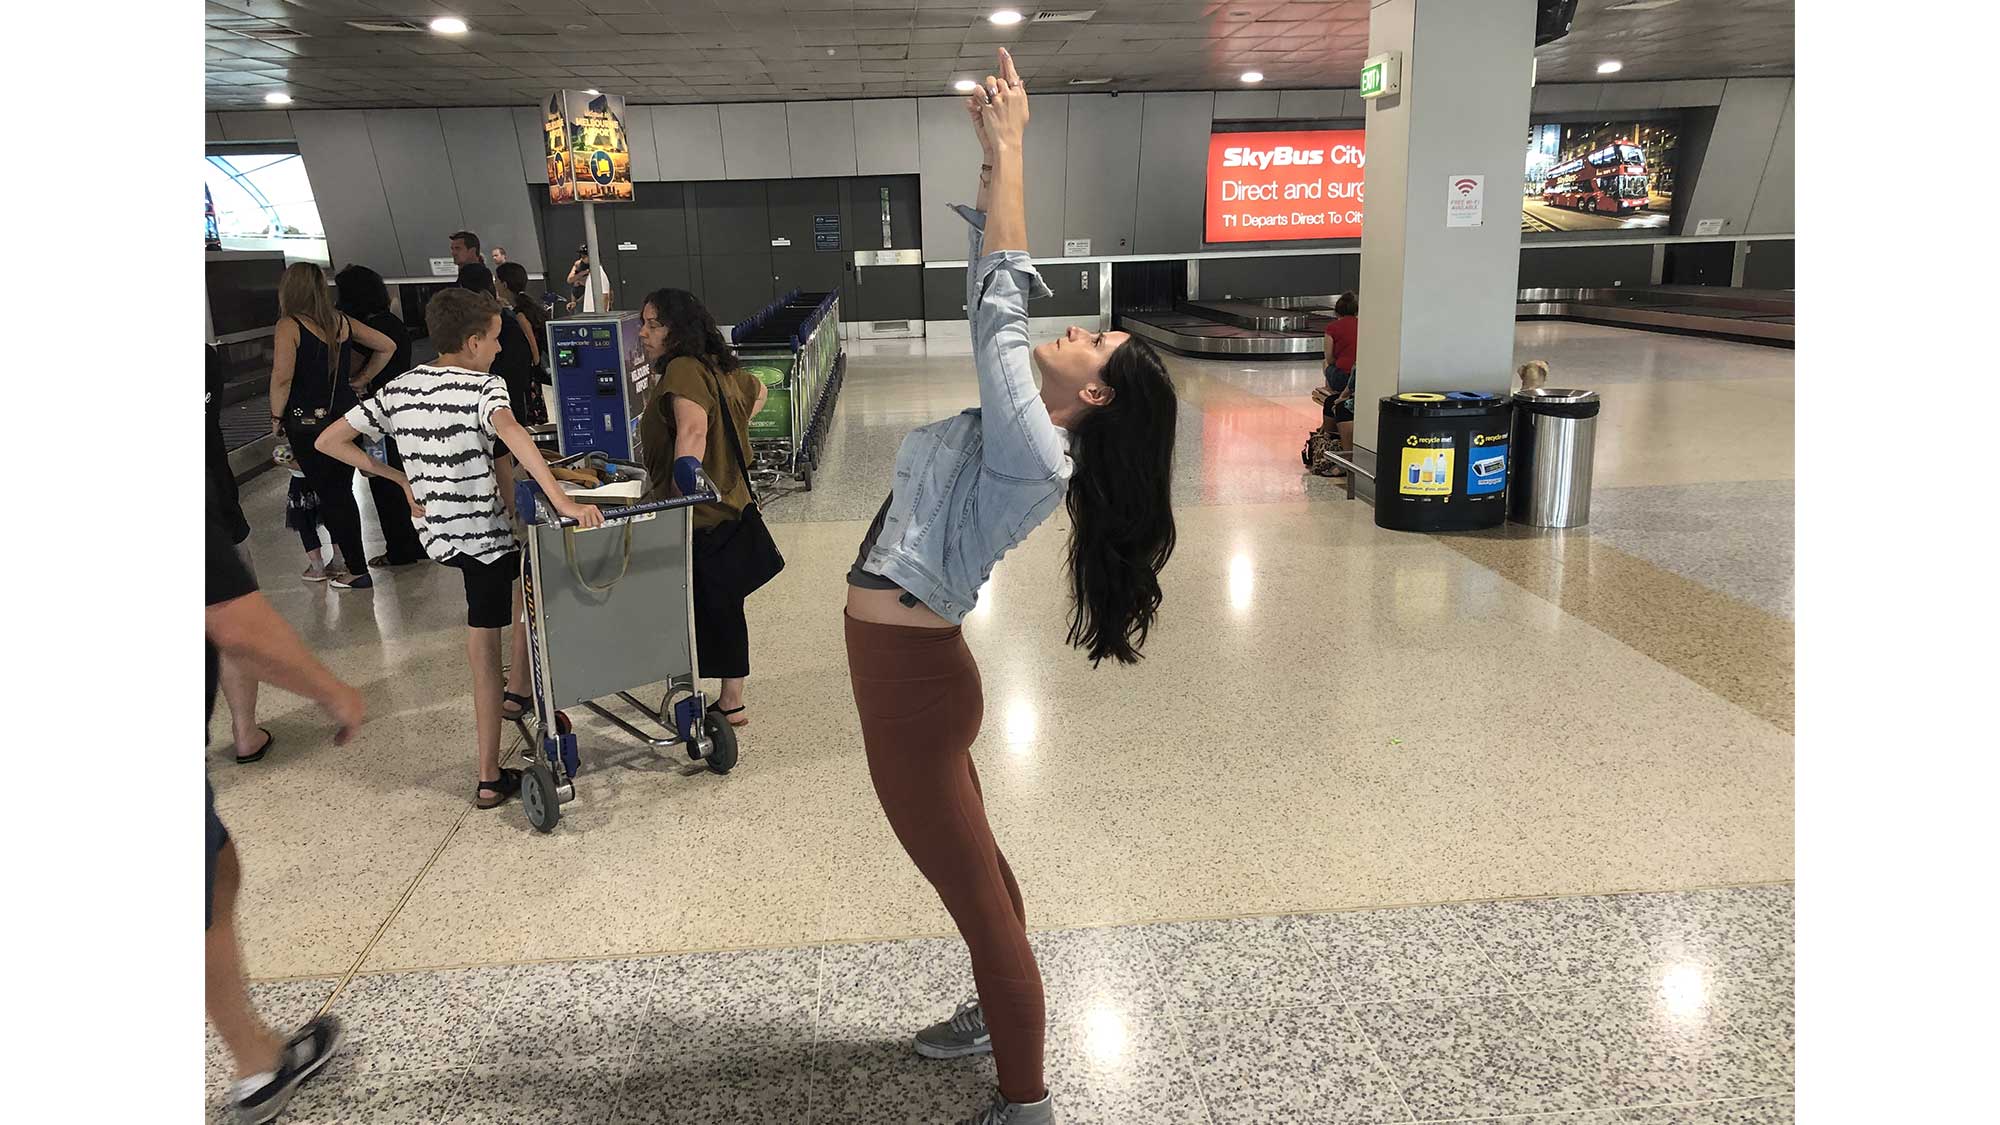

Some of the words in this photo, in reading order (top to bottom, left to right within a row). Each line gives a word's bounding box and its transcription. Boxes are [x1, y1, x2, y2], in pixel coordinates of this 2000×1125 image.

[1363, 70, 1376, 91] EXIT
[1222, 146, 1324, 170] SkyBus
[1222, 180, 1278, 201] Direct
[1284, 178, 1322, 199] and
[1222, 215, 1237, 227] T1
[1242, 213, 1288, 228] Departs
[1291, 212, 1324, 225] Direct
[1328, 211, 1341, 224] To
[1419, 436, 1440, 444] recycle
